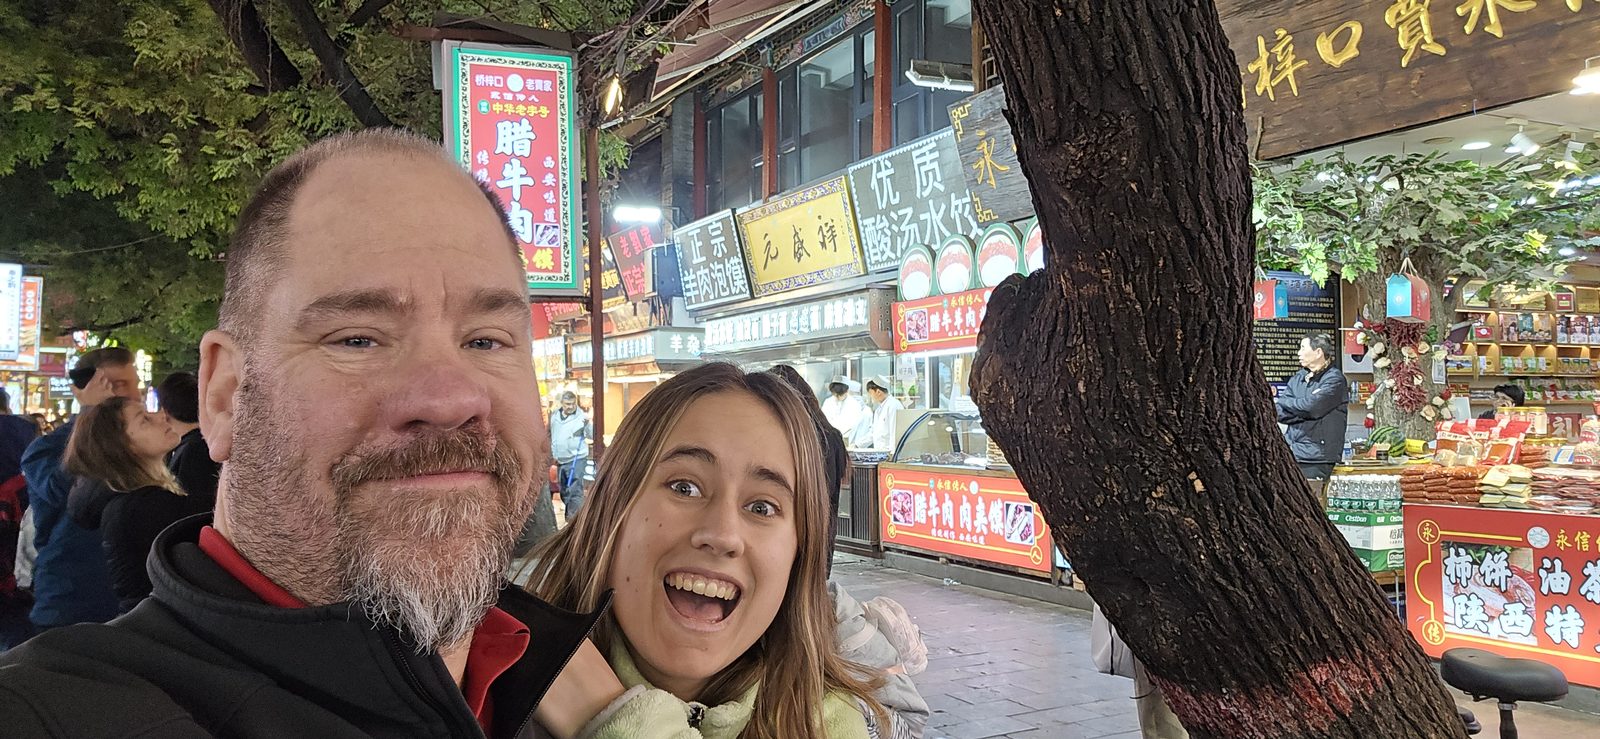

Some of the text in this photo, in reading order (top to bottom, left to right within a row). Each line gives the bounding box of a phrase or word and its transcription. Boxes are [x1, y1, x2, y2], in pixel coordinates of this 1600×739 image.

[492, 102, 550, 118] 中华老字号
[870, 142, 945, 210] 优质
[972, 129, 1017, 189] 永
[541, 155, 557, 223] 西安味道
[687, 220, 728, 265] 正宗
[862, 189, 984, 264] 酸汤水饺
[623, 262, 645, 296] 正宗
[683, 256, 747, 304] 羊肉泡馍
[914, 490, 1005, 536] 腊牛肉 肉夹馍
[1422, 523, 1436, 541] 永
[1452, 592, 1600, 653] 陕西特
